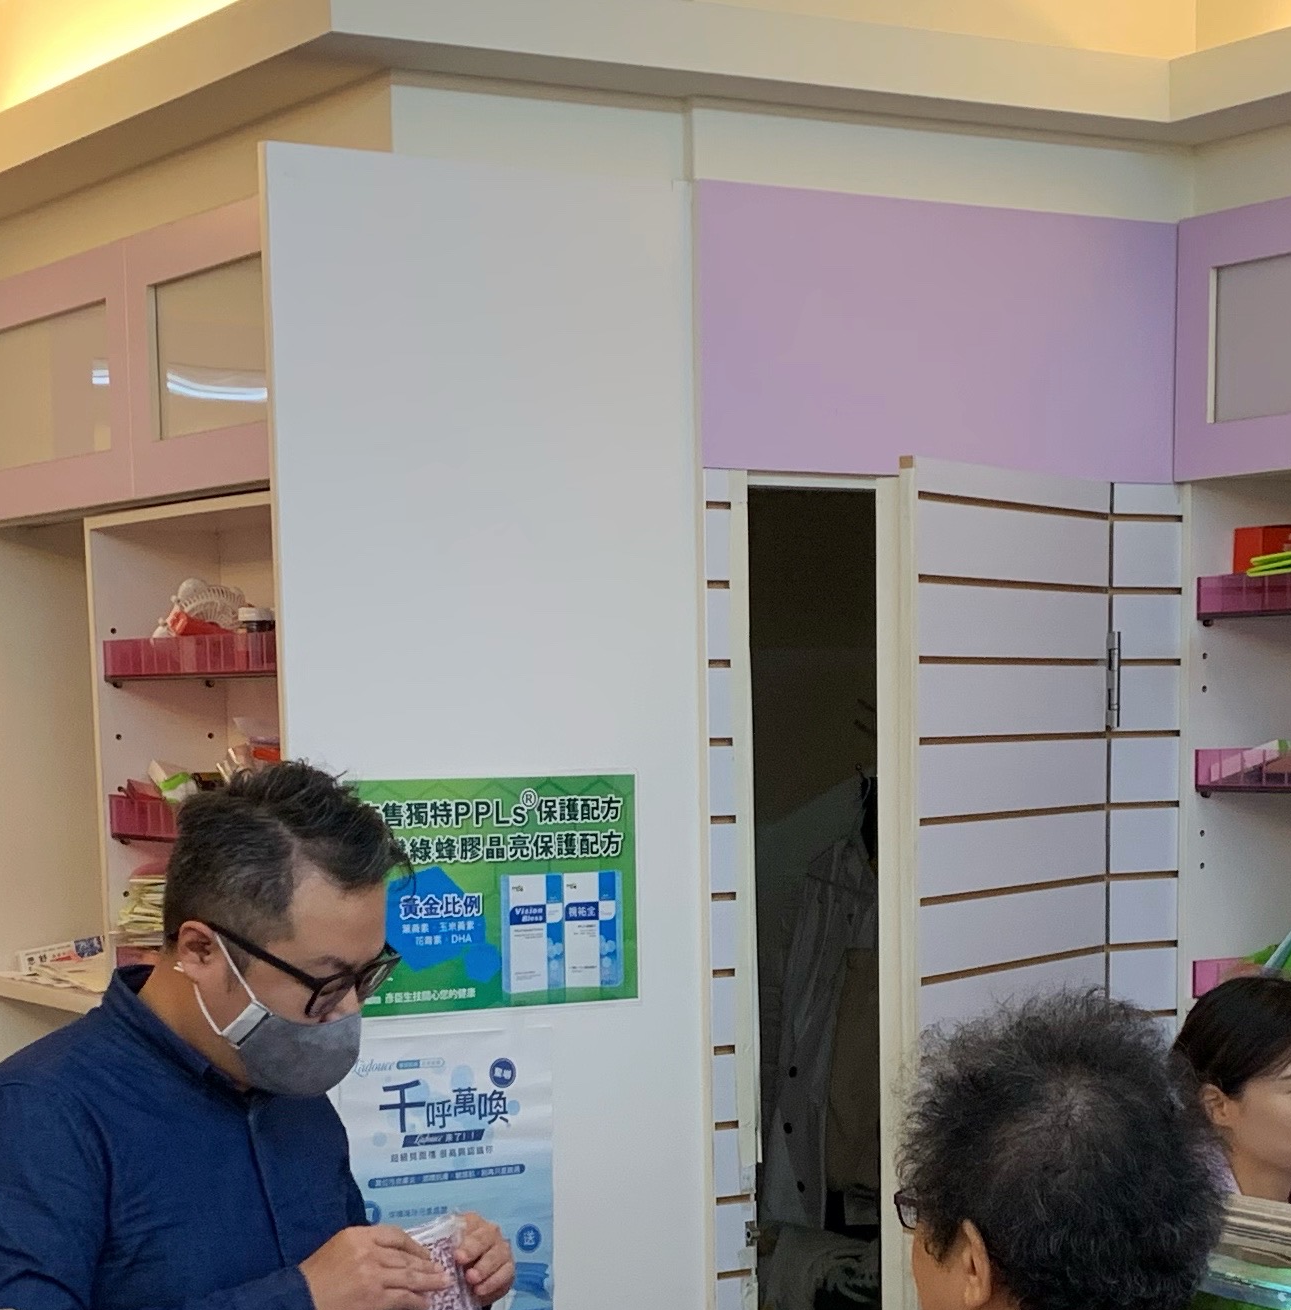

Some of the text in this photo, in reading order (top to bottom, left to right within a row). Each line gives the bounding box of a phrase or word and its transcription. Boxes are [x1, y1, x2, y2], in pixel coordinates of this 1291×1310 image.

[374, 790, 622, 828] 售獨特PPLs®保護配方
[398, 832, 622, 862] 綠蜂膠晶亮保護配方
[400, 893, 482, 920] 黃金比例
[379, 1080, 509, 1133] 千呼萬喚
